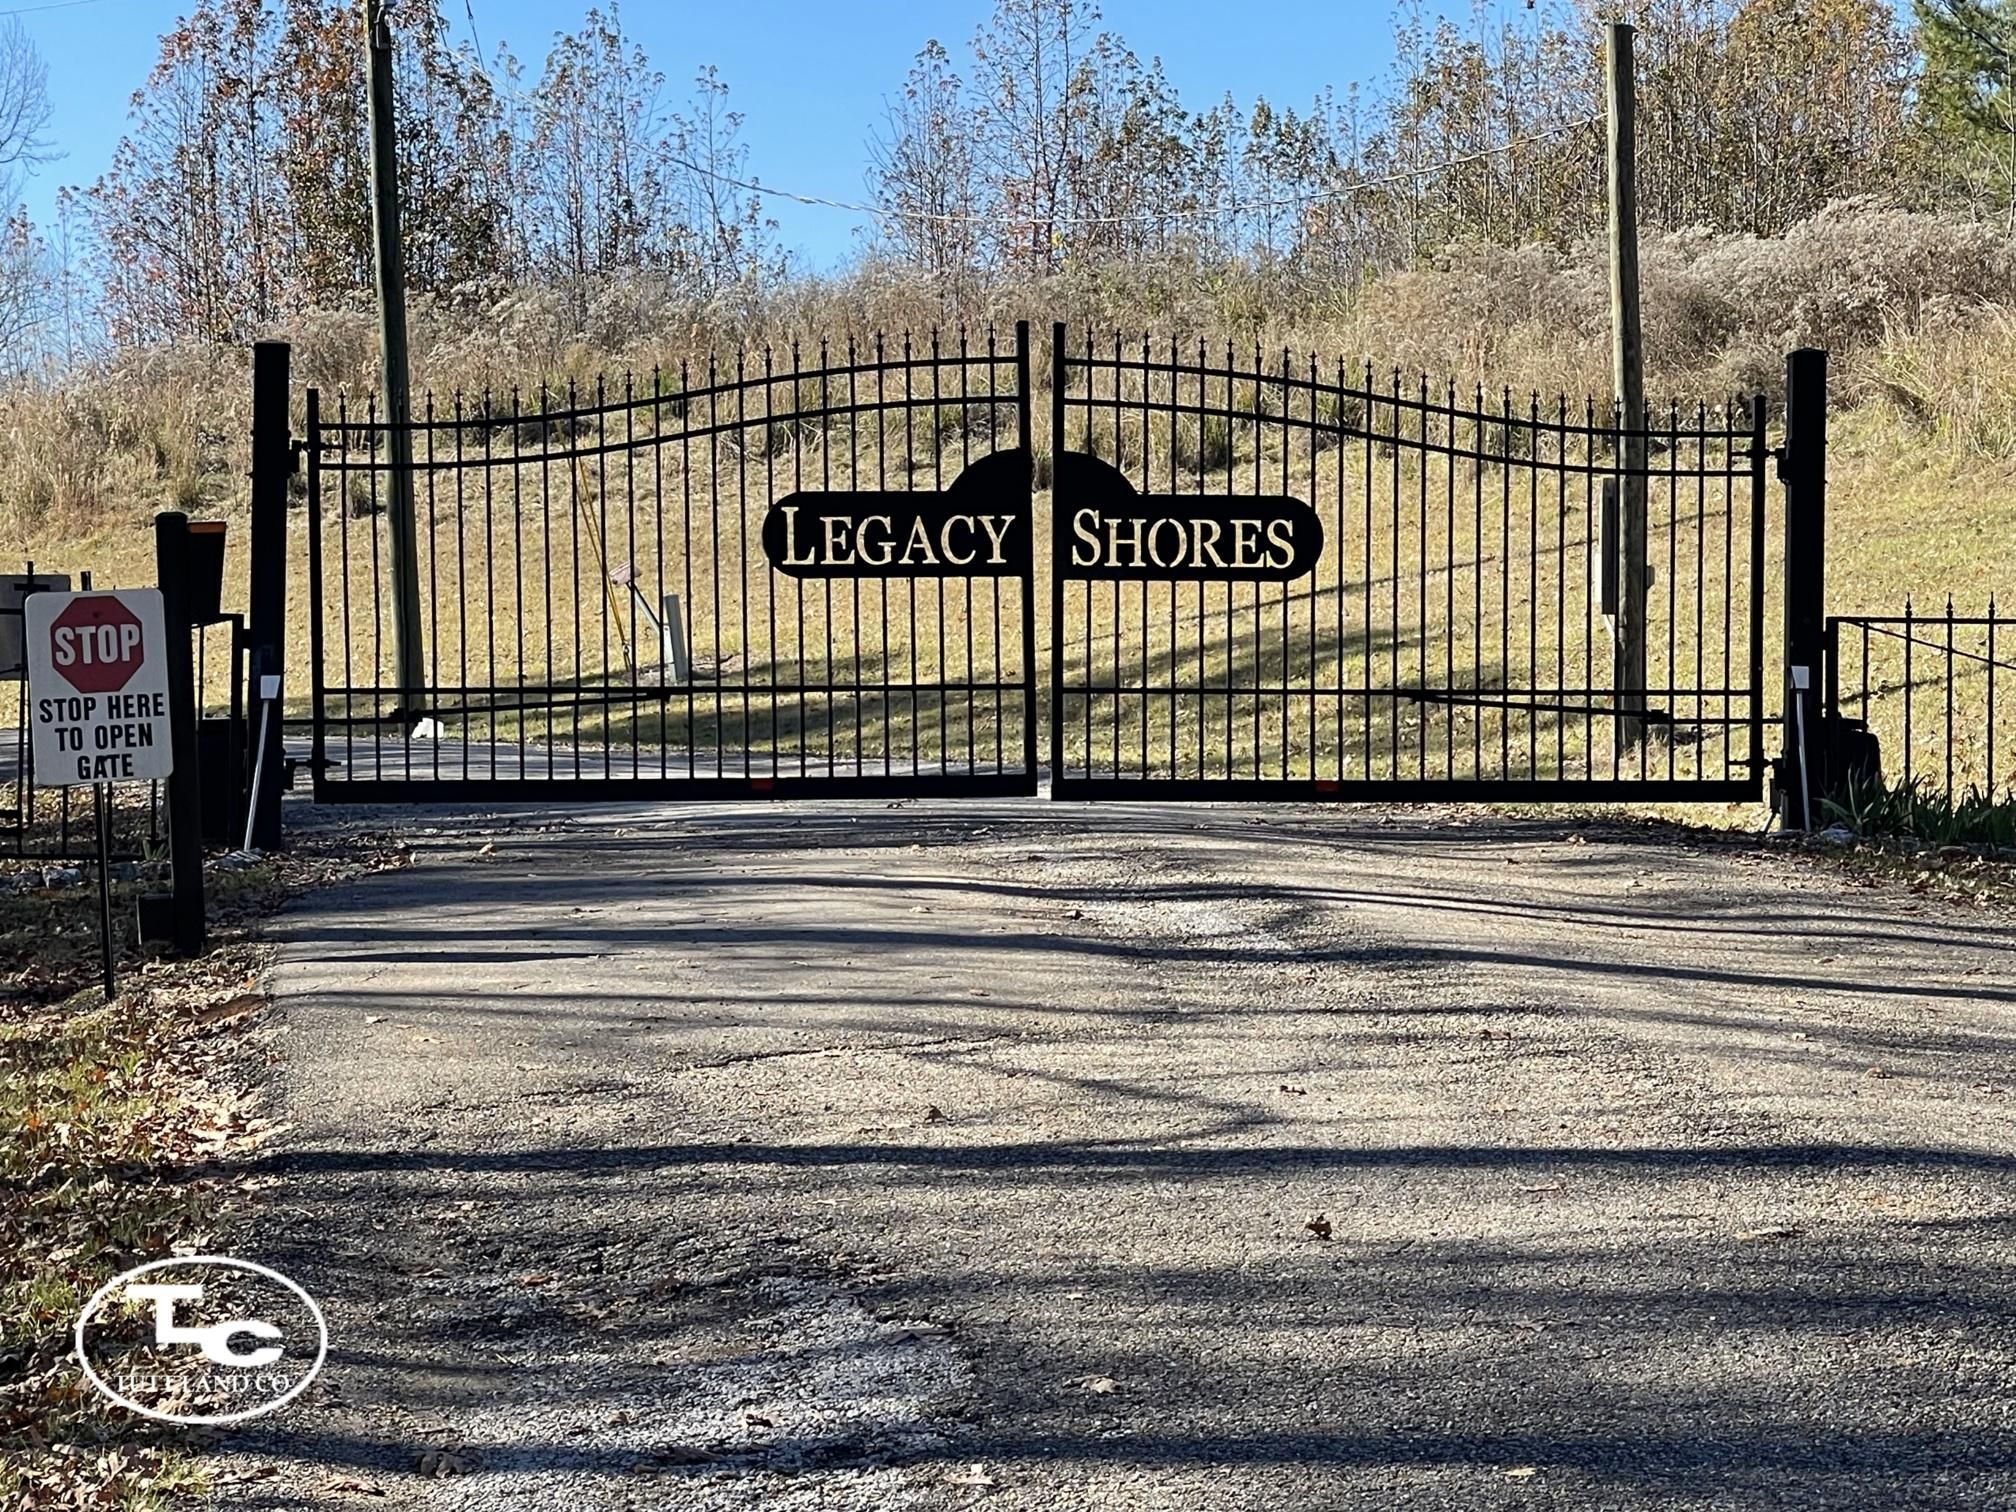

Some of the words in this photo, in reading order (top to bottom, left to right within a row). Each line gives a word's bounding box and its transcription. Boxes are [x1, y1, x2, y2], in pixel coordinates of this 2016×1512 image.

[781, 506, 1016, 565] LEGACY
[1072, 508, 1295, 569] SHORES
[54, 623, 140, 666] STOP
[39, 697, 97, 723] STOP
[107, 693, 165, 720] HERE
[55, 727, 83, 751] TO
[95, 723, 153, 750] OPEN
[77, 754, 134, 780] GATE
